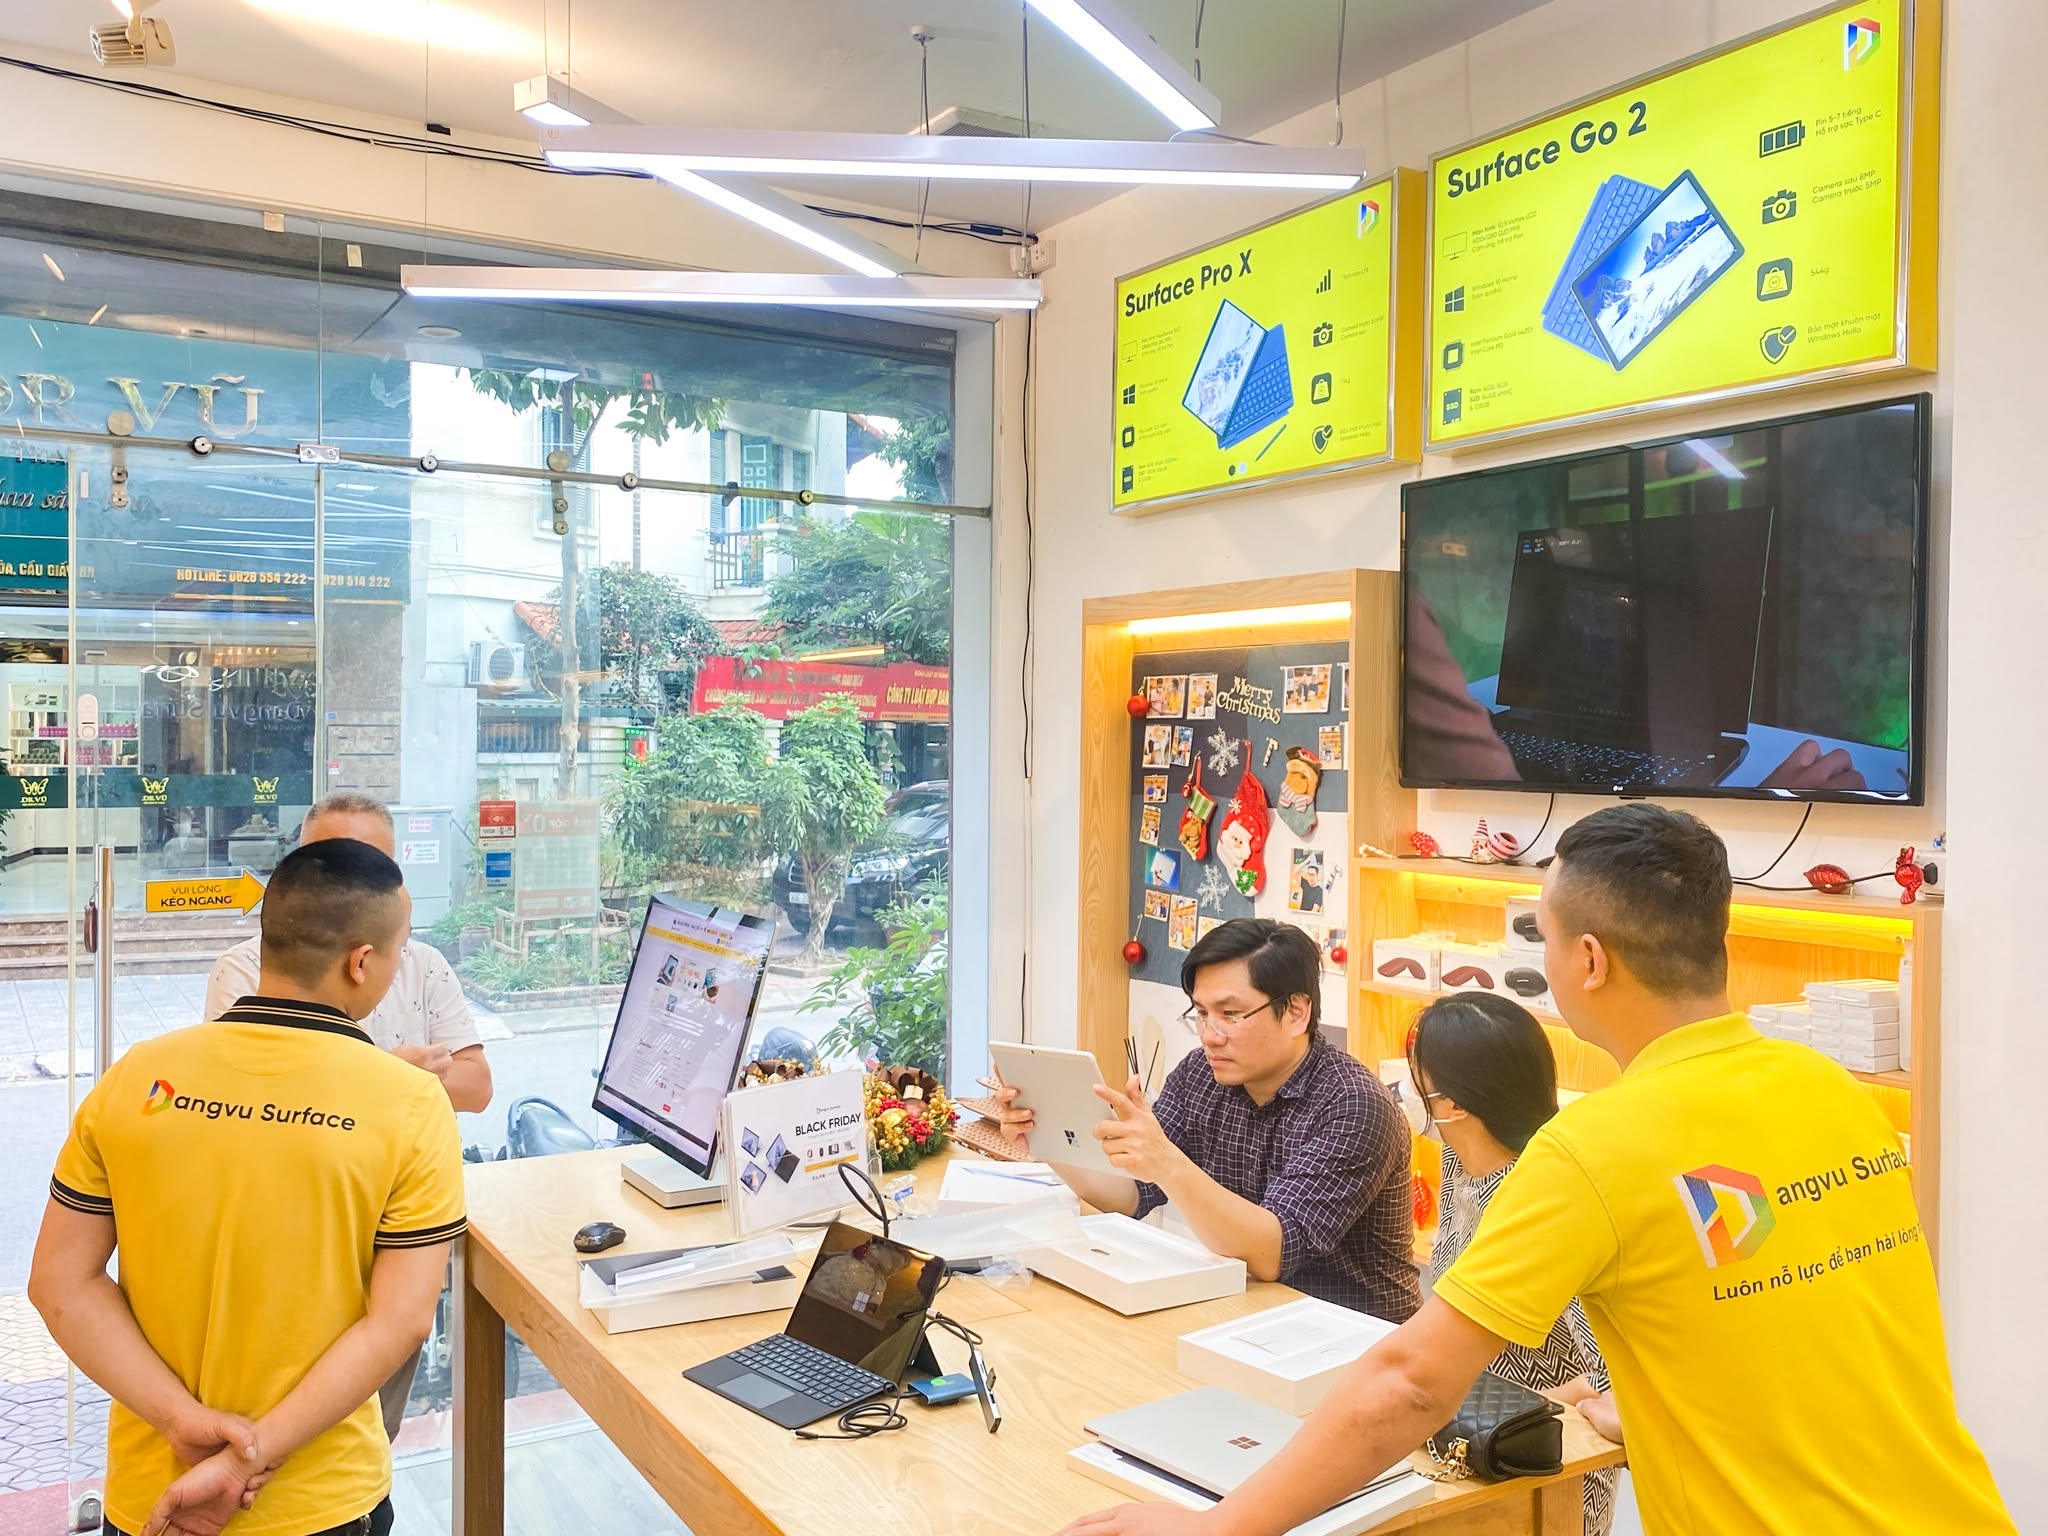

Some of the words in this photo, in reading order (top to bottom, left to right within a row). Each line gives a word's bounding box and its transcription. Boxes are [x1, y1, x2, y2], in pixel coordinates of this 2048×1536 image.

[1816, 119, 1827, 127] Pin
[1829, 113, 1841, 123] 5-7
[1856, 113, 1873, 125] Type
[1448, 140, 1560, 198] Surface
[1570, 121, 1618, 153] Go
[1628, 101, 1647, 137] 2
[1812, 182, 1843, 194] Camera
[1844, 176, 1858, 185] sau
[1812, 191, 1842, 203] Camera
[1865, 178, 1882, 189] 5MP
[1125, 277, 1194, 317] Surface
[1201, 264, 1232, 290] Pro
[1239, 249, 1252, 278] X
[1808, 331, 1841, 343] Windows
[1842, 327, 1862, 337] Hello
[106, 373, 265, 439] VŨ
[1446, 402, 1459, 410] SSD
[259, 573, 280, 584] 554
[284, 573, 306, 585] 222
[369, 575, 390, 588] 222
[1231, 676, 1273, 708] Merry
[1217, 691, 1281, 724] Christmas
[172, 887, 189, 895] VUI
[189, 896, 232, 906] NGANG
[260, 1103, 355, 1131] Surface
[795, 1120, 827, 1136] BLACK
[829, 1112, 861, 1129] FRIDAY
[1713, 1280, 1763, 1301] Luôn
[1770, 1265, 1793, 1289] nỗ
[1798, 1263, 1824, 1283] lực
[1829, 1247, 1844, 1271] để
[1846, 1243, 1871, 1265] bạn
[1876, 1234, 1896, 1253] hài
